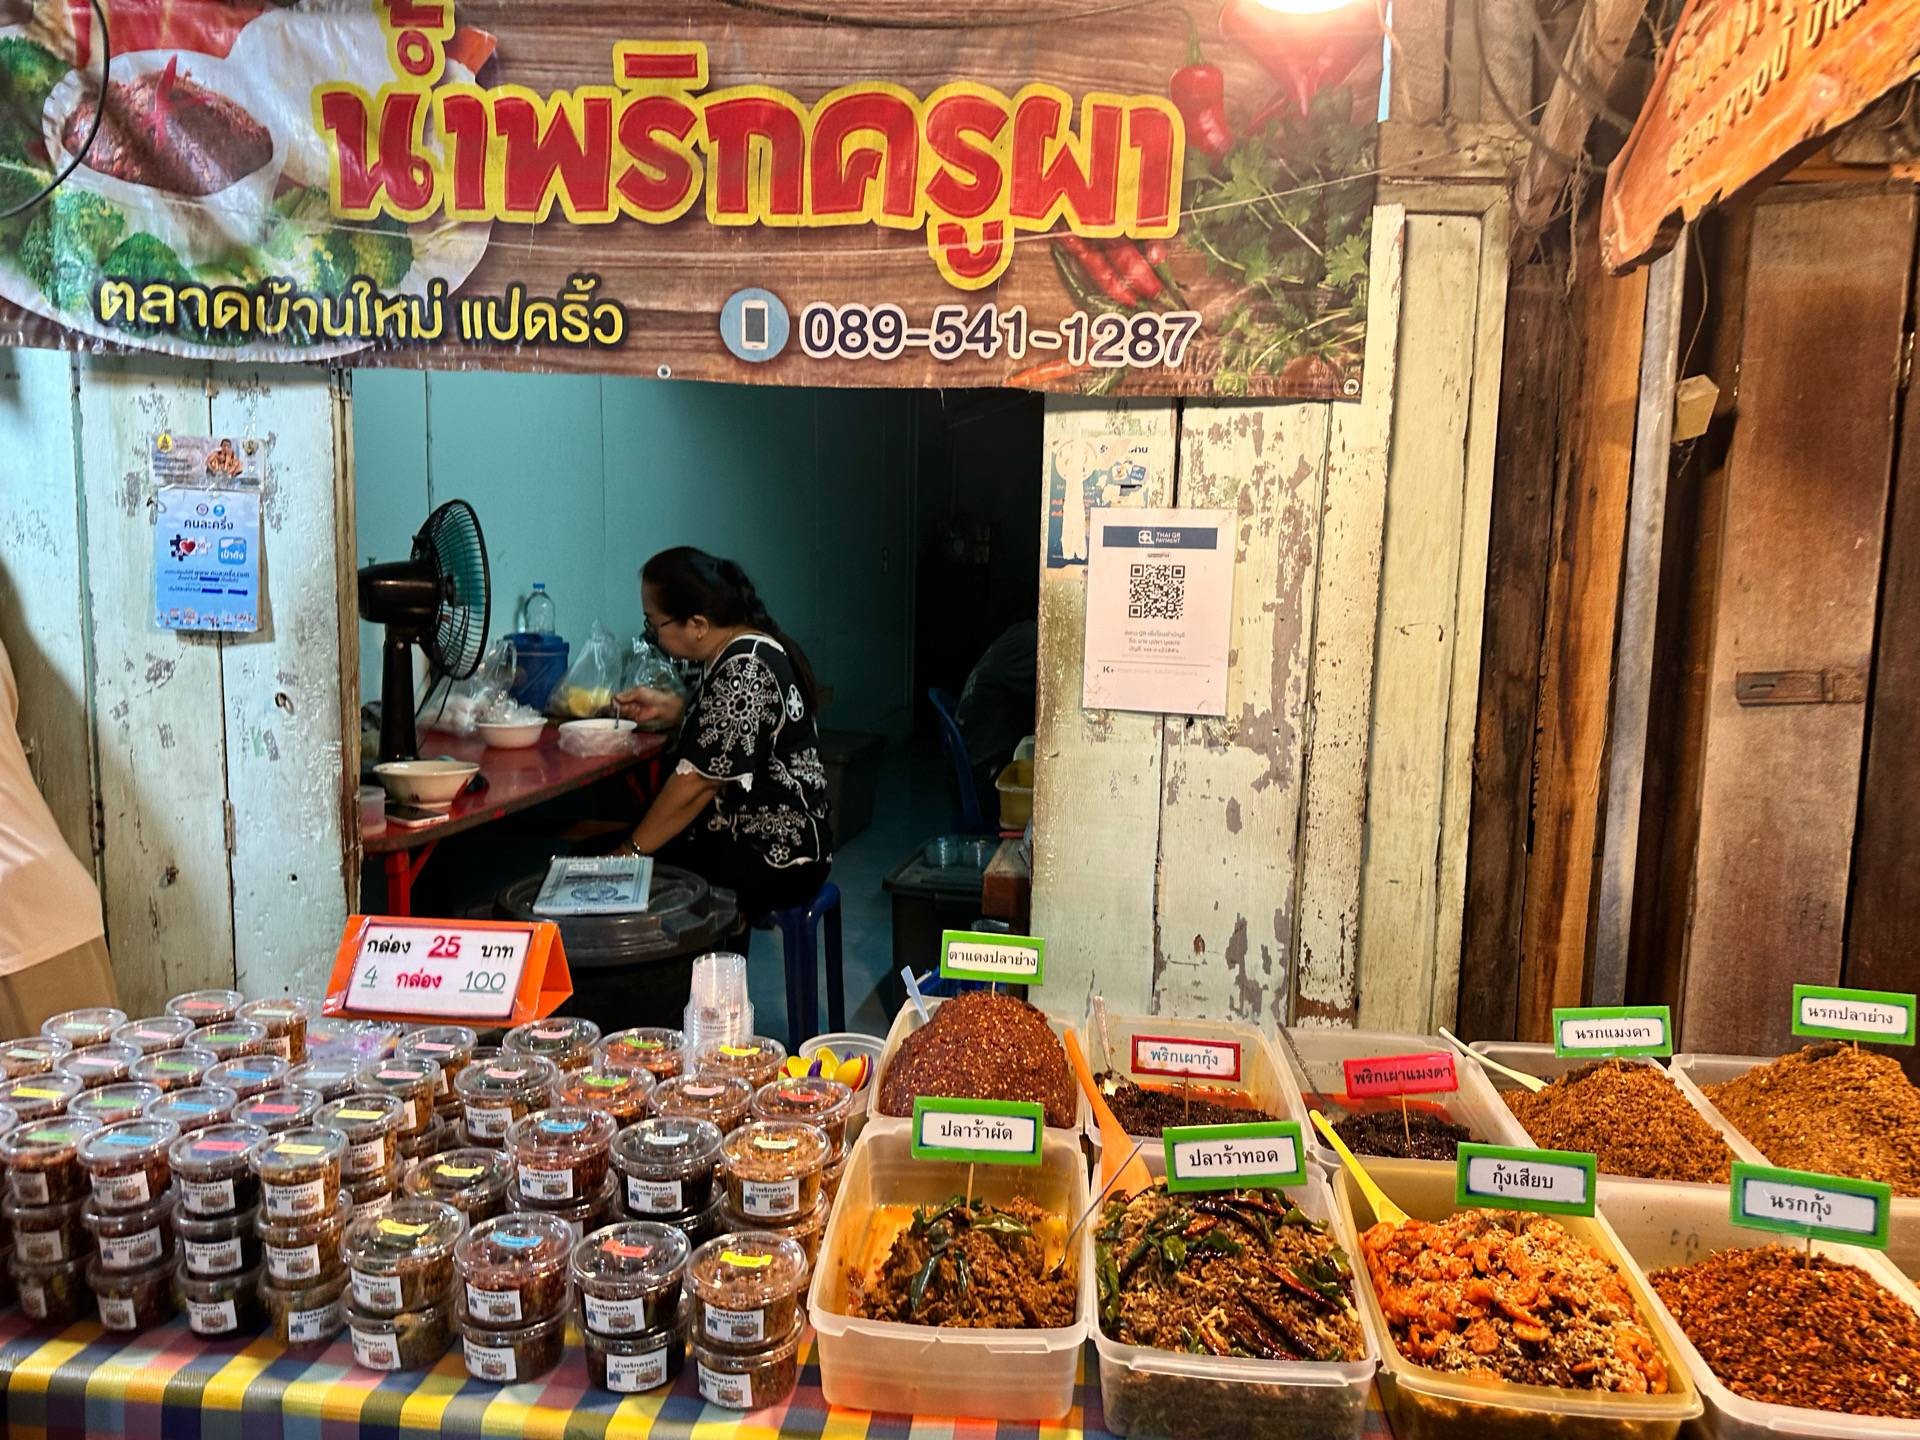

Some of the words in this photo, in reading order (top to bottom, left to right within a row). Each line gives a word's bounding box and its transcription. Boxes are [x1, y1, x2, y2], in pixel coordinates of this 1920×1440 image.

[99, 279, 444, 341] ตลาดบ้านใหม่
[461, 278, 624, 345] แปดริ้ว
[799, 304, 1201, 366] 089-541-1287
[367, 934, 411, 954] กล่อง
[427, 935, 462, 960] 25
[481, 944, 514, 958] บาท
[362, 965, 378, 988] 4
[396, 968, 443, 989] กล่อง
[462, 970, 507, 993] 100
[1808, 1006, 1893, 1024] นรกปลาย่าง
[1575, 1027, 1651, 1039] นรกแมงดา
[1150, 1046, 1218, 1070] พริกเผากุ้ง
[1354, 1066, 1451, 1084] พริกเผาแมงดา
[940, 1119, 1013, 1142] ปลาร้าผัด
[1188, 1140, 1279, 1168] ปลาร้าทอด
[1492, 1163, 1554, 1192] กุ้งเสียบ
[1769, 1192, 1832, 1222] นรกกุ้ง
